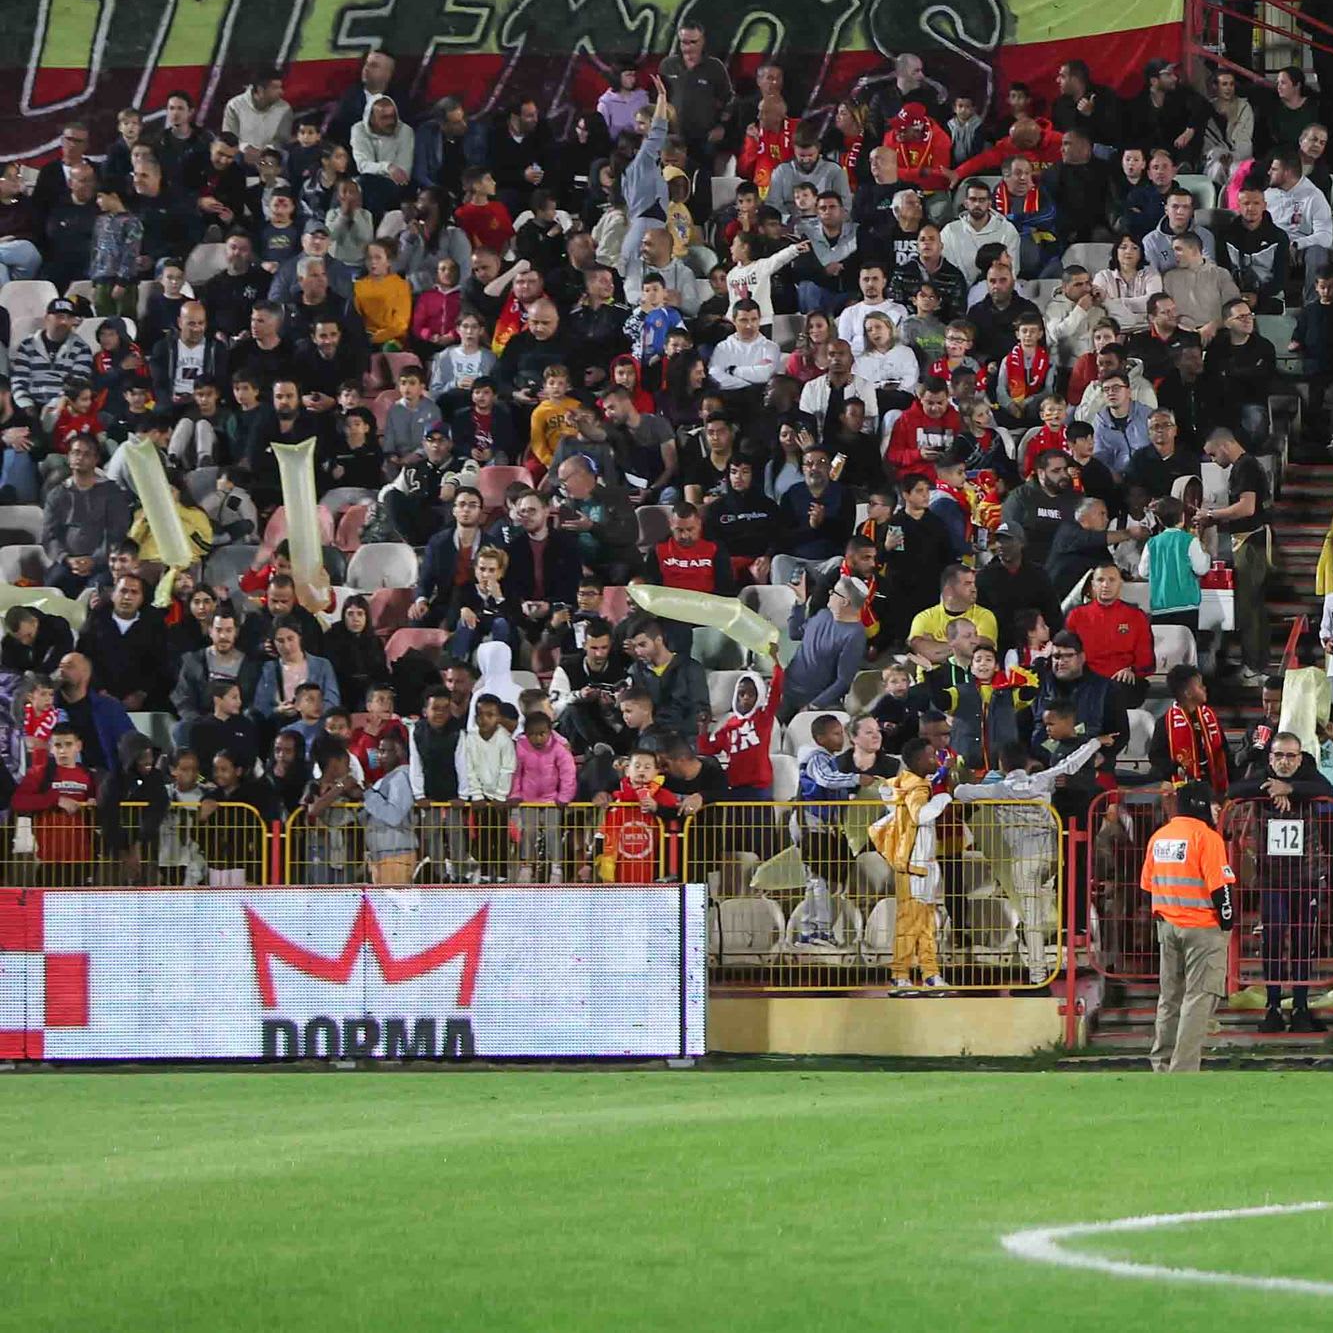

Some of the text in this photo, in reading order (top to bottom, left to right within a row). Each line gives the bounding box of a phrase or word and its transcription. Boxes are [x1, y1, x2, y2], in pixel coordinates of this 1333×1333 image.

[690, 558, 713, 568] AIR
[1281, 825, 1299, 850] 12
[259, 1014, 476, 1061] DORMA
